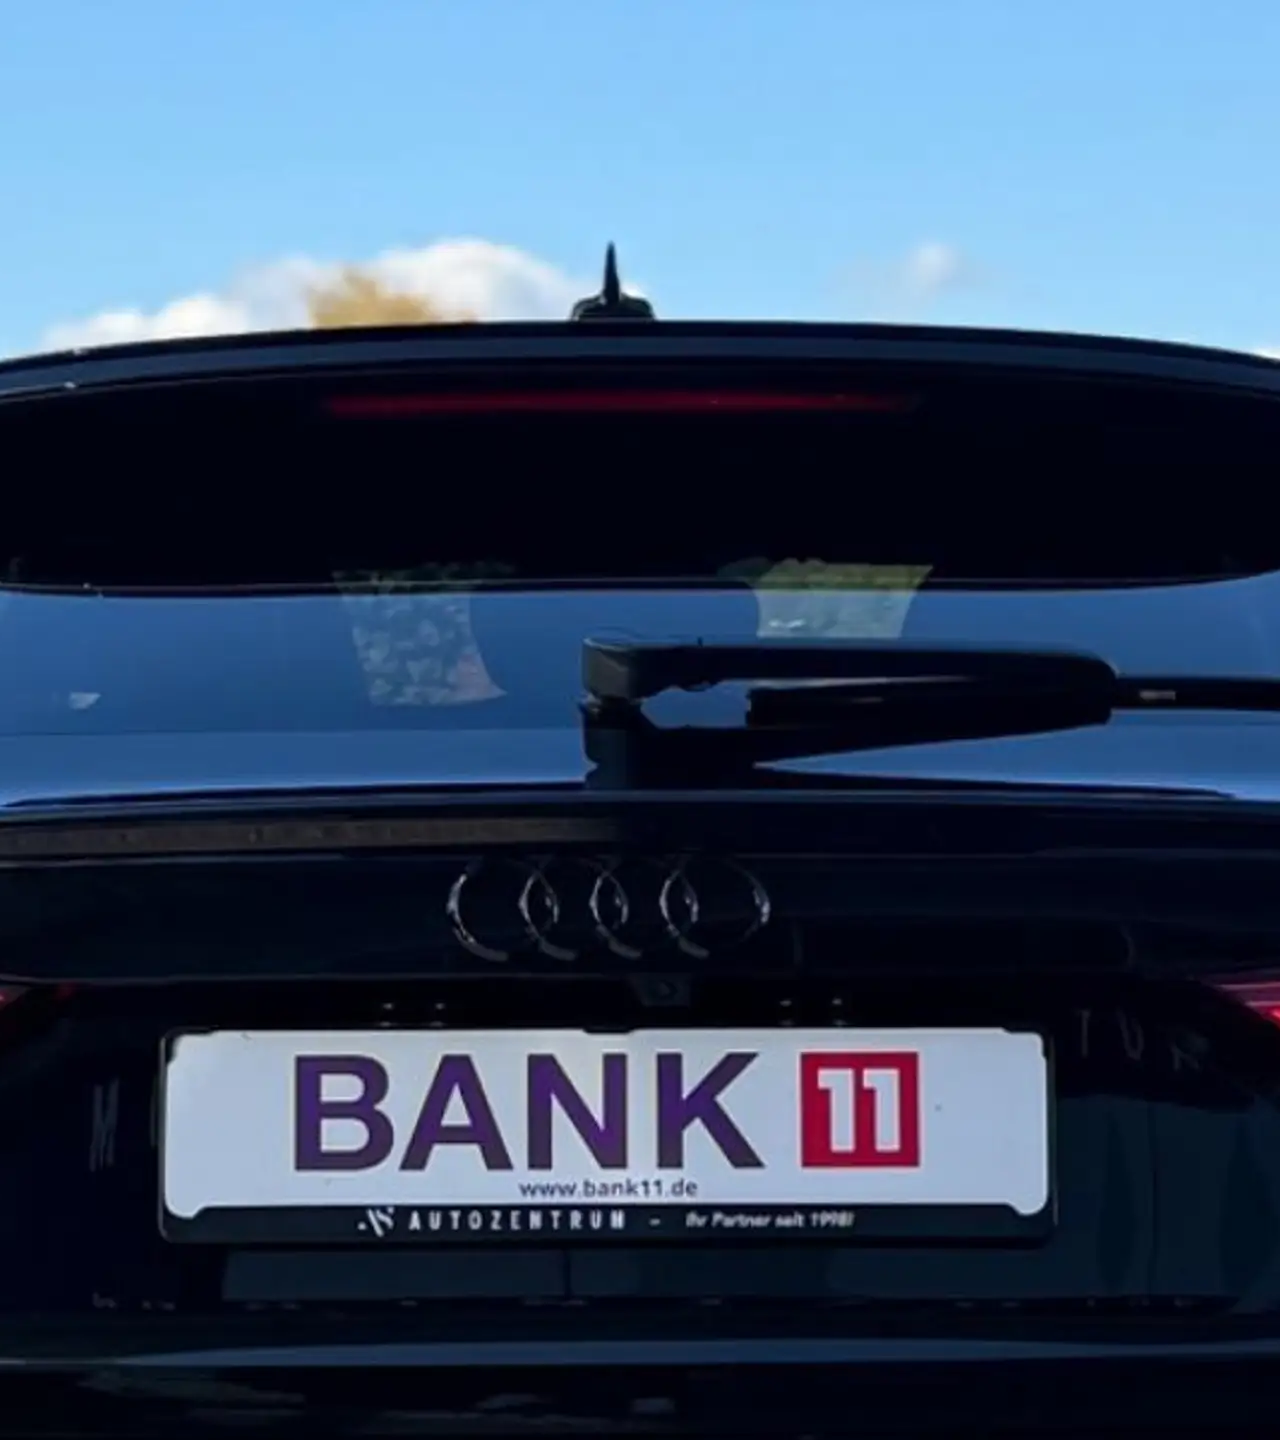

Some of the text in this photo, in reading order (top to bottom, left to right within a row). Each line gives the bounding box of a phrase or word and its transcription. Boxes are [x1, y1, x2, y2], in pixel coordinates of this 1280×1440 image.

[293, 1052, 902, 1173] BANK 11
[518, 1178, 699, 1198] www.bank11.de
[408, 1210, 625, 1231] AUTOZENTRUM
[712, 1211, 770, 1228] Partner
[775, 1211, 805, 1228] seit
